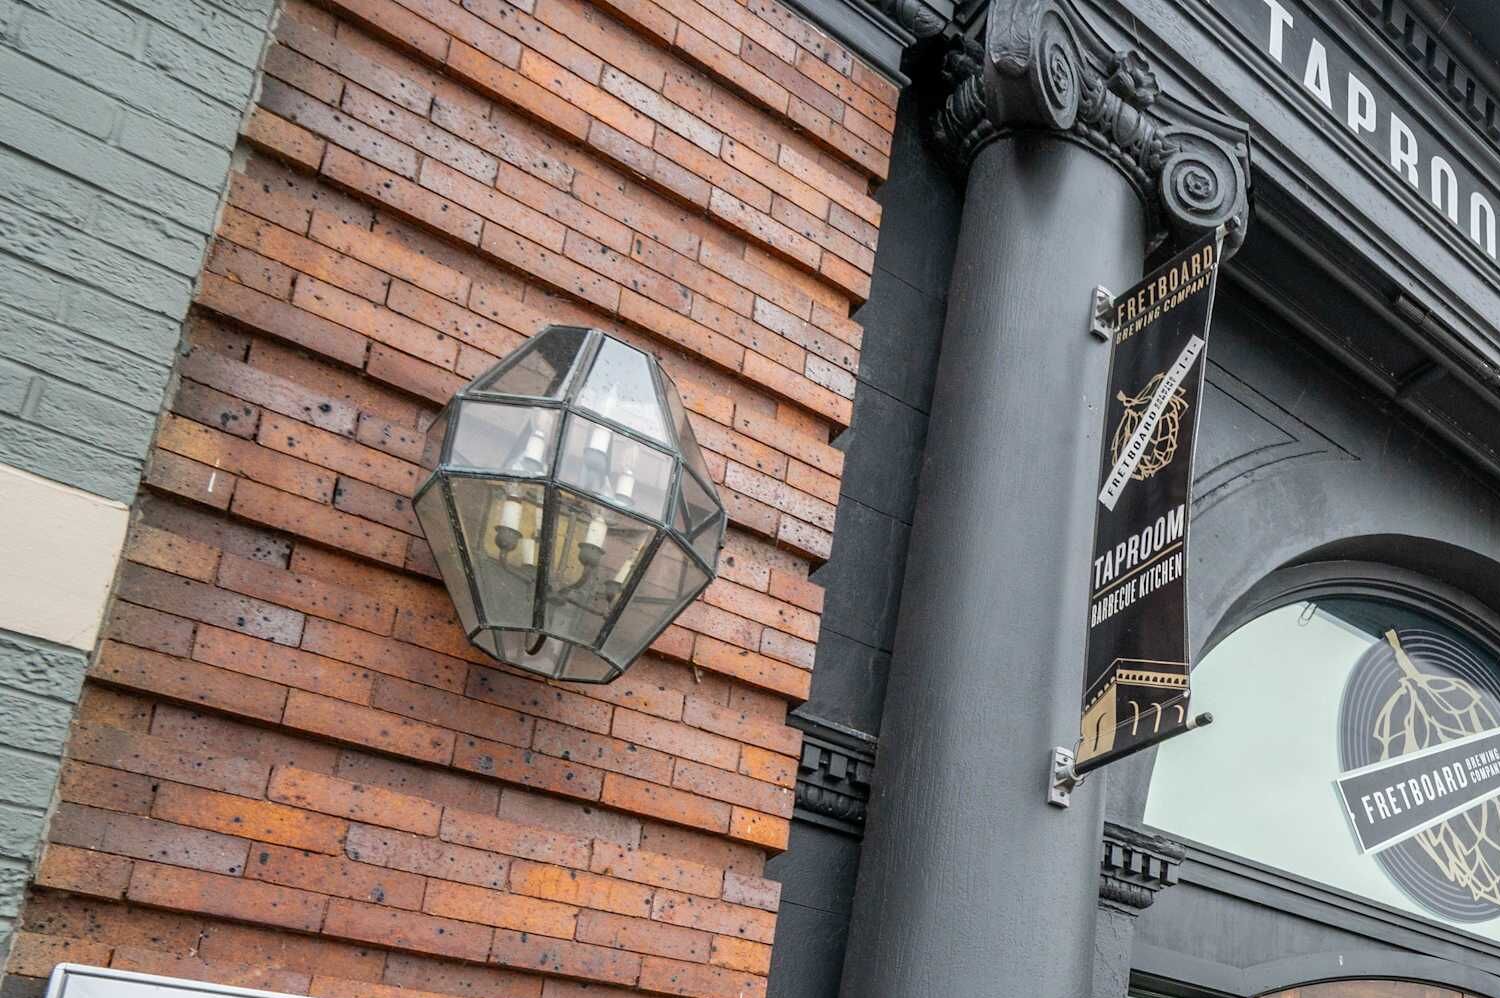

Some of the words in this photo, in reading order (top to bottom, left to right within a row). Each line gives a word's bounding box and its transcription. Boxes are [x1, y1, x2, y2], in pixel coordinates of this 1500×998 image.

[1116, 310, 1160, 345] BREWING
[1163, 271, 1212, 313] COMPANY
[1117, 245, 1213, 328] FRETBOARD
[1108, 411, 1157, 497] FRETBOARD
[1095, 503, 1186, 590] TAPROOM
[1091, 579, 1137, 628] BARBECUE
[1139, 551, 1183, 599] KITCHEN
[1361, 761, 1468, 825] FRETBOARD
[1465, 748, 1500, 770] BREWING
